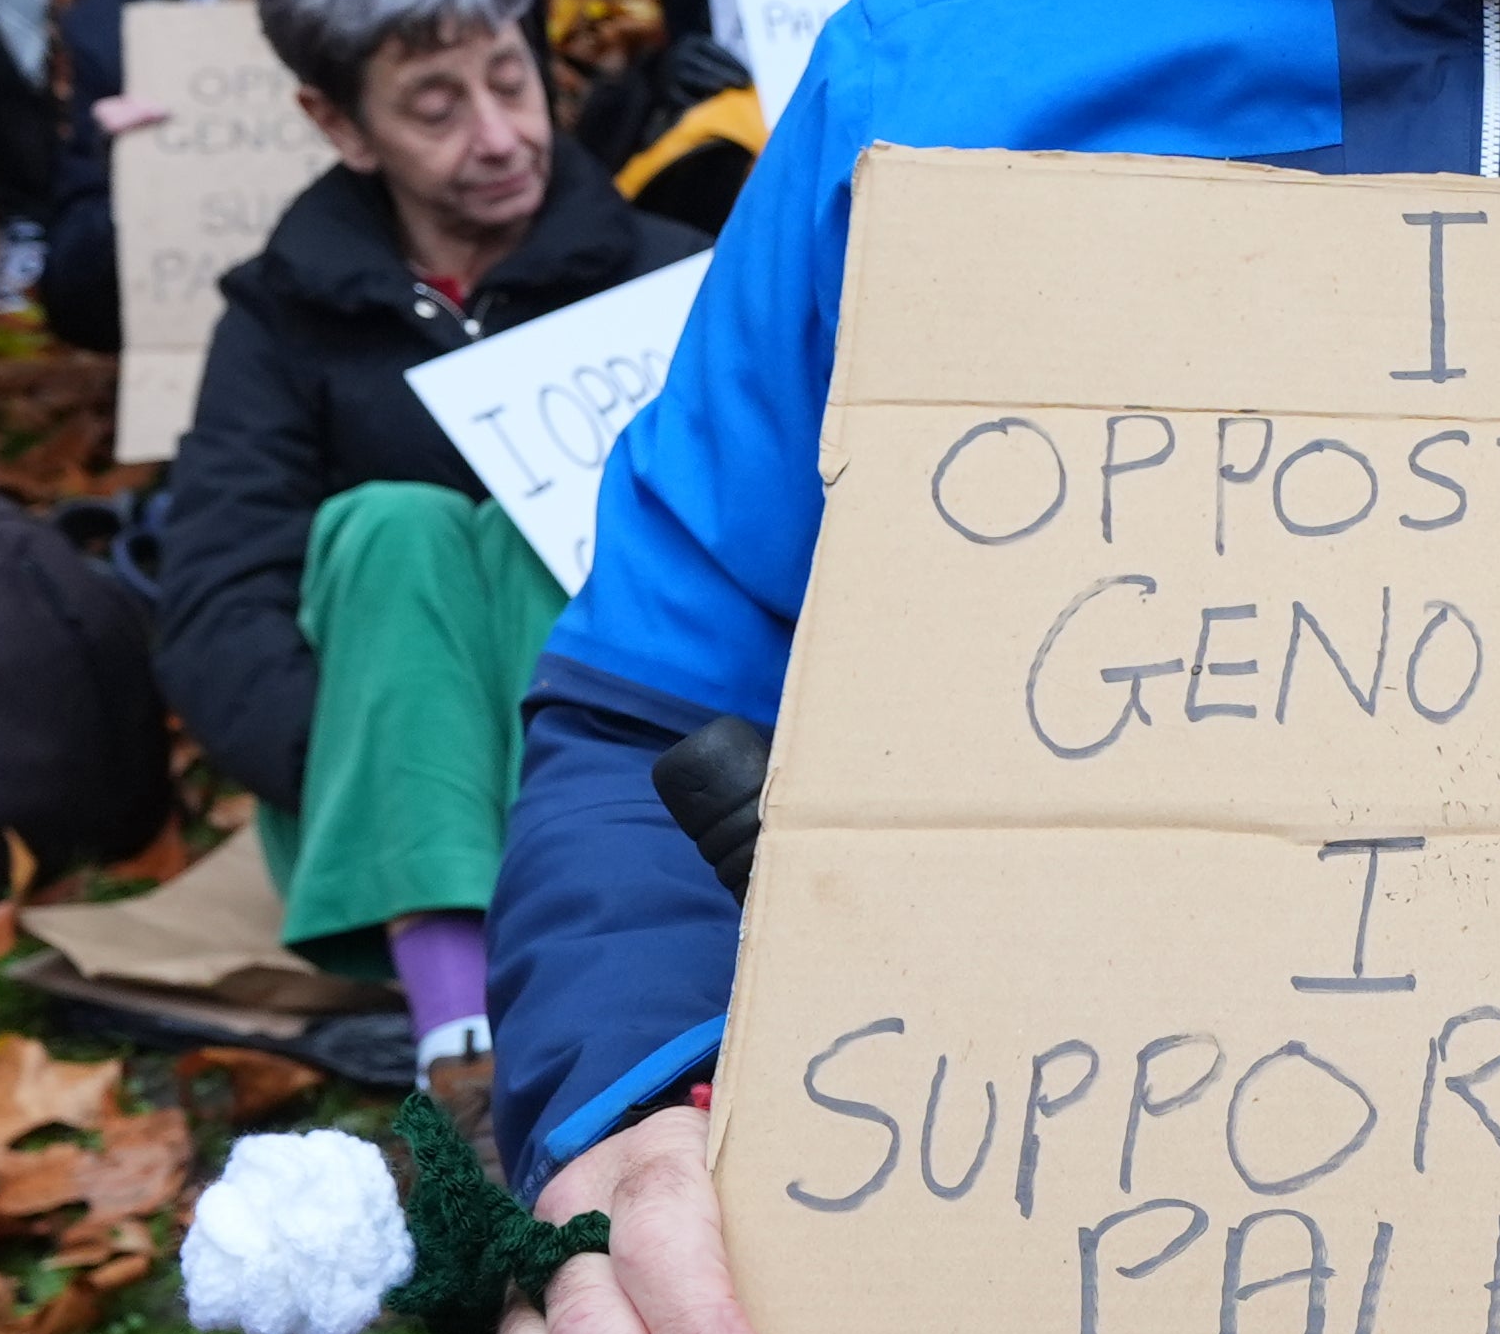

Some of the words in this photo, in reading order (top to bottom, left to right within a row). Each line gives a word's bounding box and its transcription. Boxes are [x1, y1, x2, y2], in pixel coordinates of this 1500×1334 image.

[1389, 211, 1488, 384] I
[471, 403, 556, 500] I
[538, 348, 670, 470] OPP
[1290, 835, 1426, 992] I
